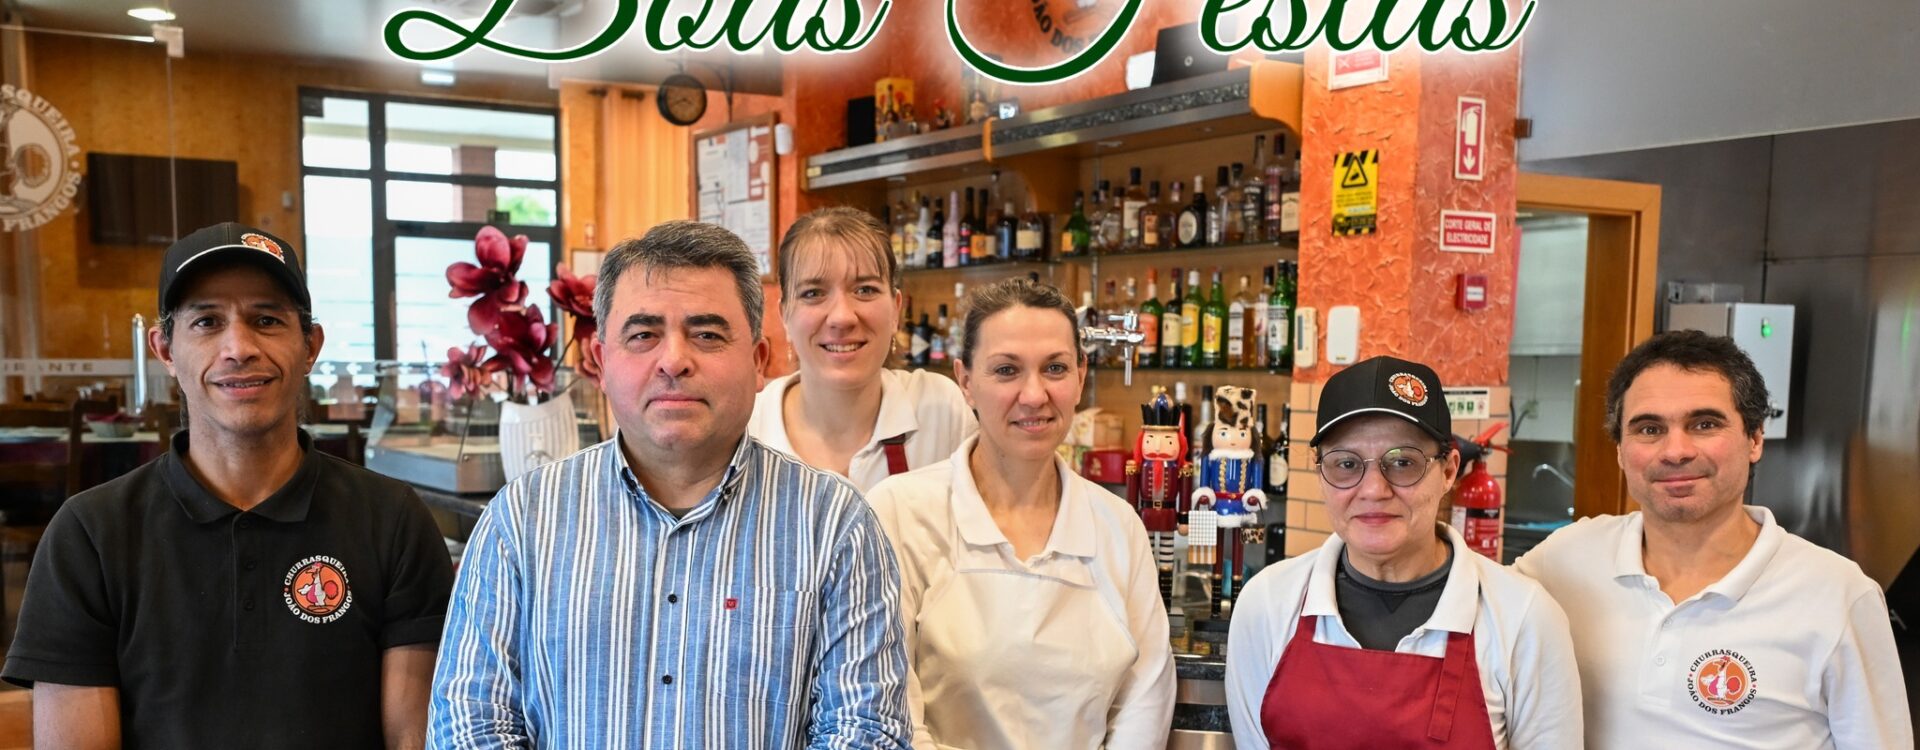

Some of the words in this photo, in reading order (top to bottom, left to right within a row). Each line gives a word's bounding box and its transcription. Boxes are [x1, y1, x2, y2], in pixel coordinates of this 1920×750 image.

[283, 592, 300, 616] JOÃO
[299, 612, 321, 624] DOS
[1690, 649, 1757, 683] CHURRASQUEIRA
[1698, 701, 1718, 715] DOS
[1720, 688, 1757, 715] FRANGOS
